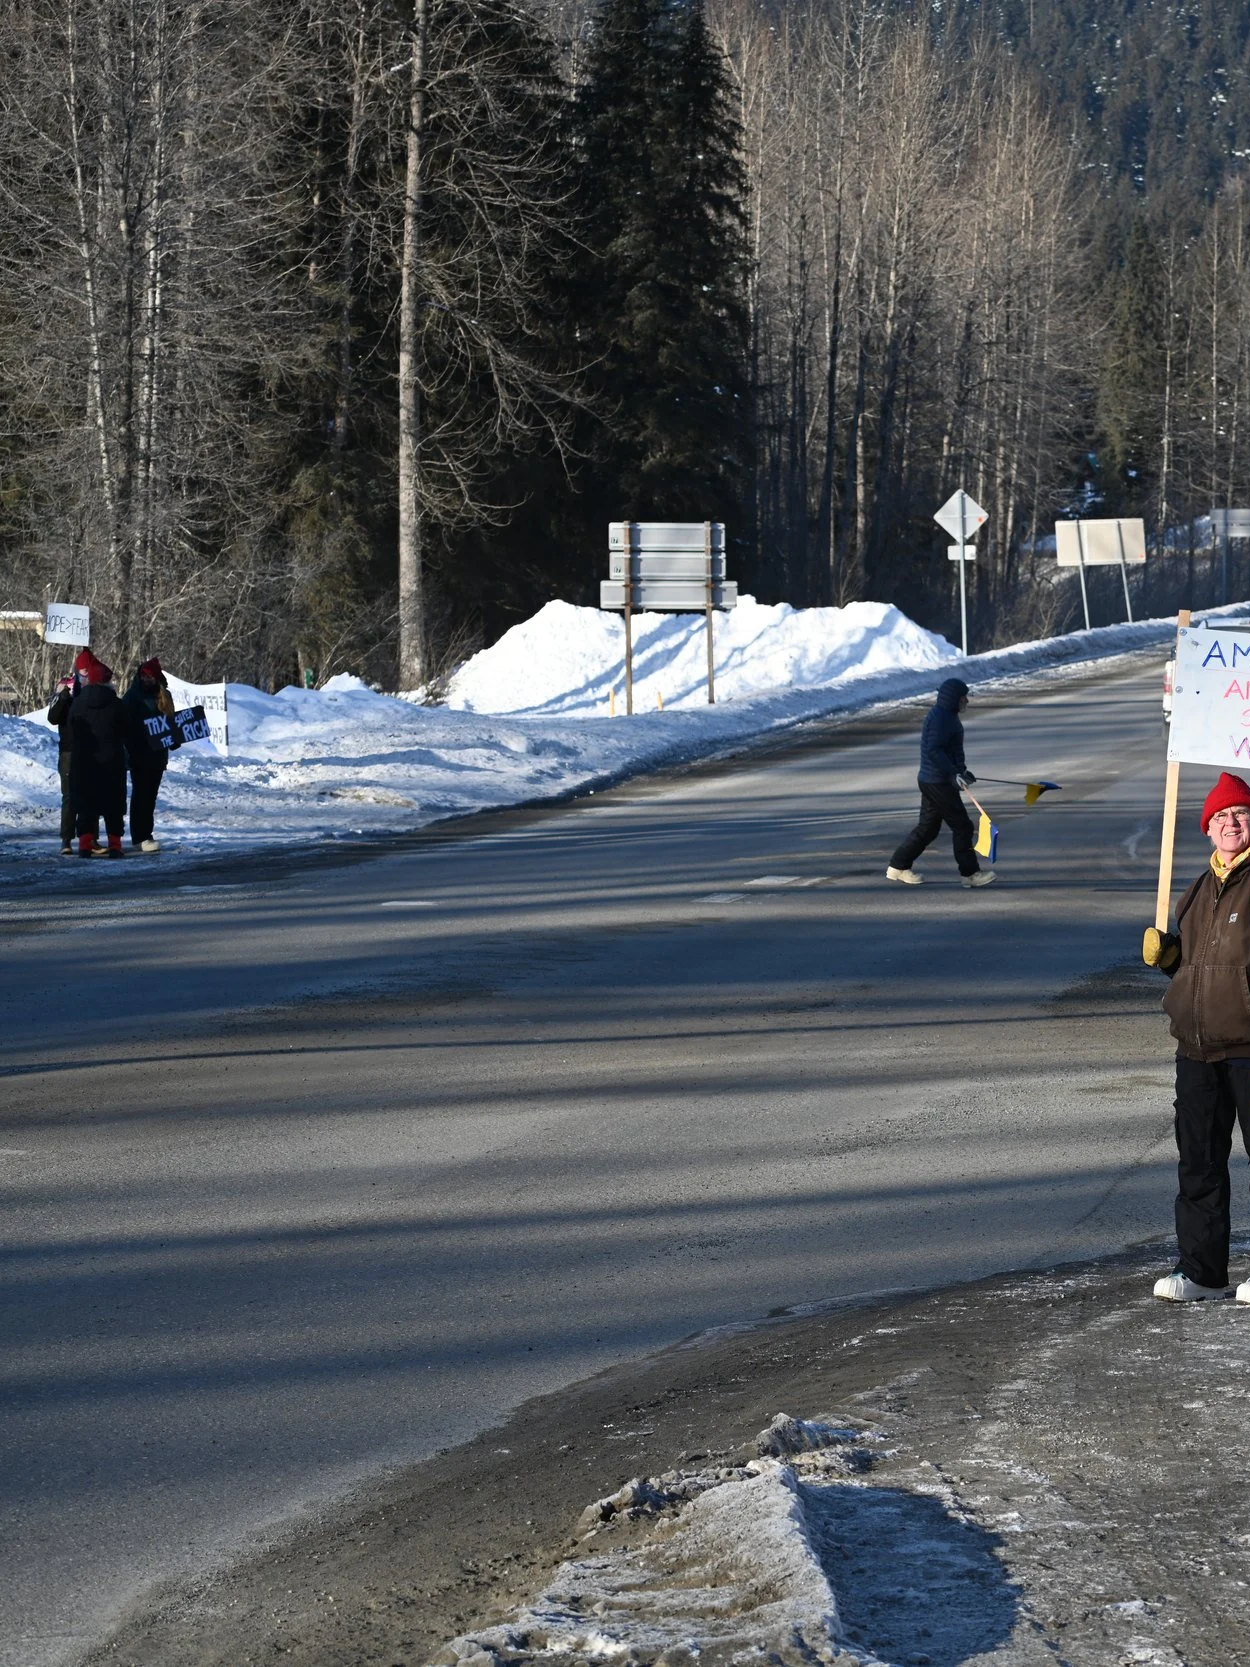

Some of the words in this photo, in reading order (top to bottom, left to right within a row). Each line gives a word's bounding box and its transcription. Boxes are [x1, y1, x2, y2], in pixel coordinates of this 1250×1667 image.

[143, 714, 170, 736] TAX
[174, 708, 195, 728] SUPER
[182, 719, 210, 741] RICH
[160, 735, 174, 748] THE
